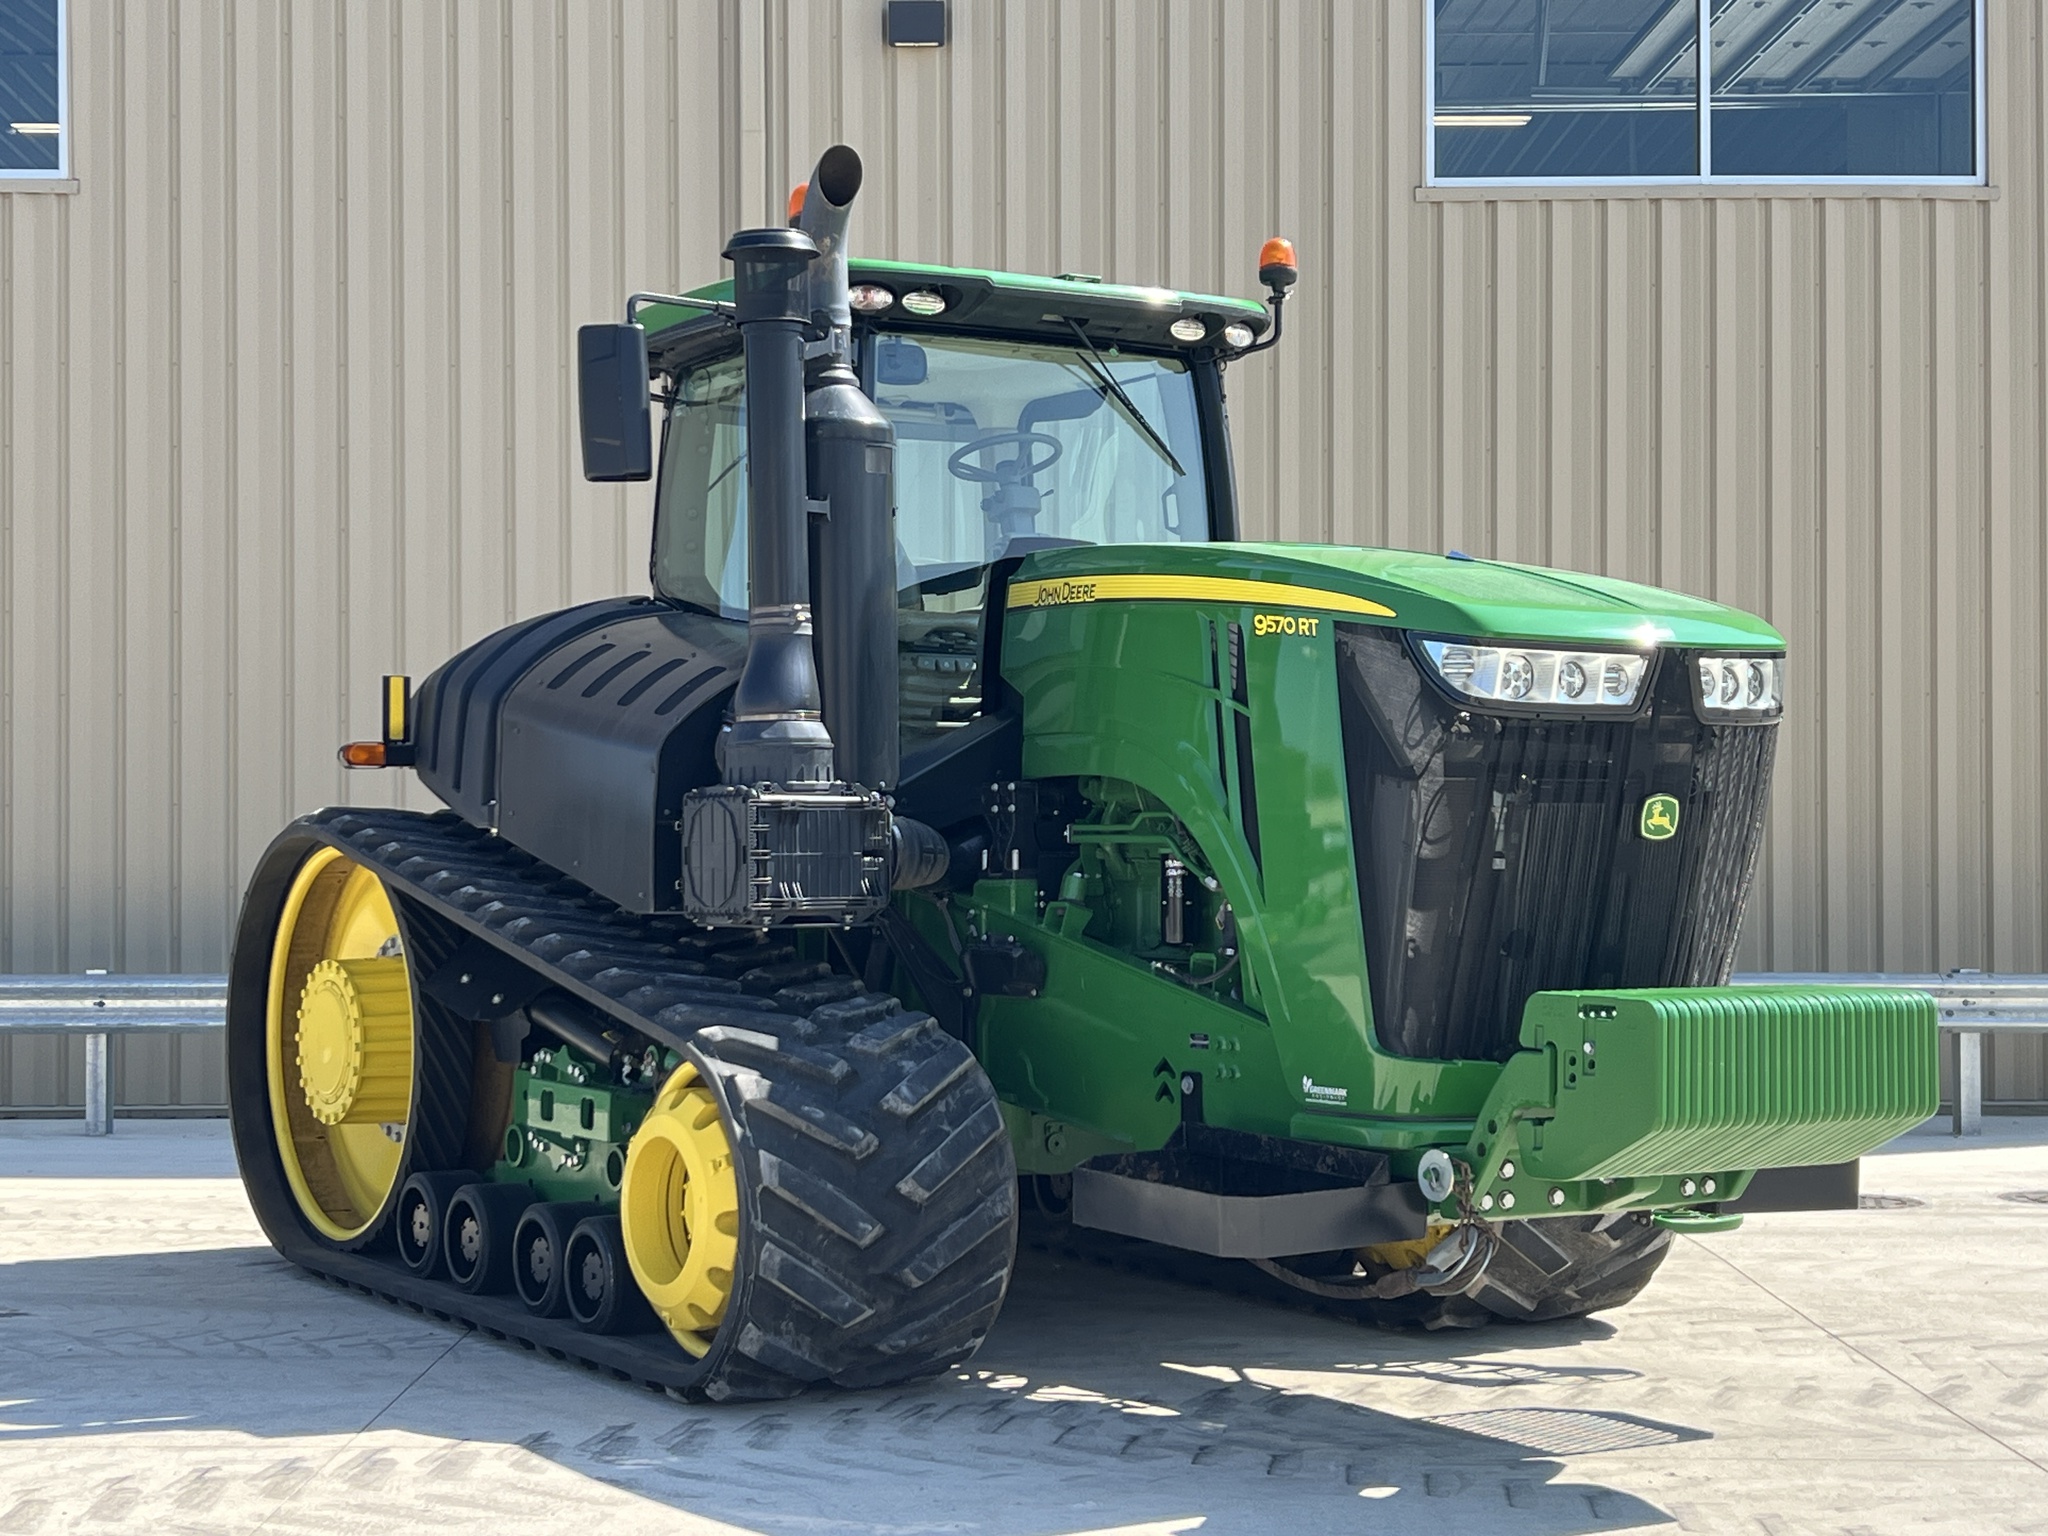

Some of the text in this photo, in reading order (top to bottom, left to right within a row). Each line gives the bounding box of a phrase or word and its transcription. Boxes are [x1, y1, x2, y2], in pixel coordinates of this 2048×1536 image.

[1034, 582, 1097, 604] JOHN DEERE
[1254, 614, 1319, 637] 9570 RT
